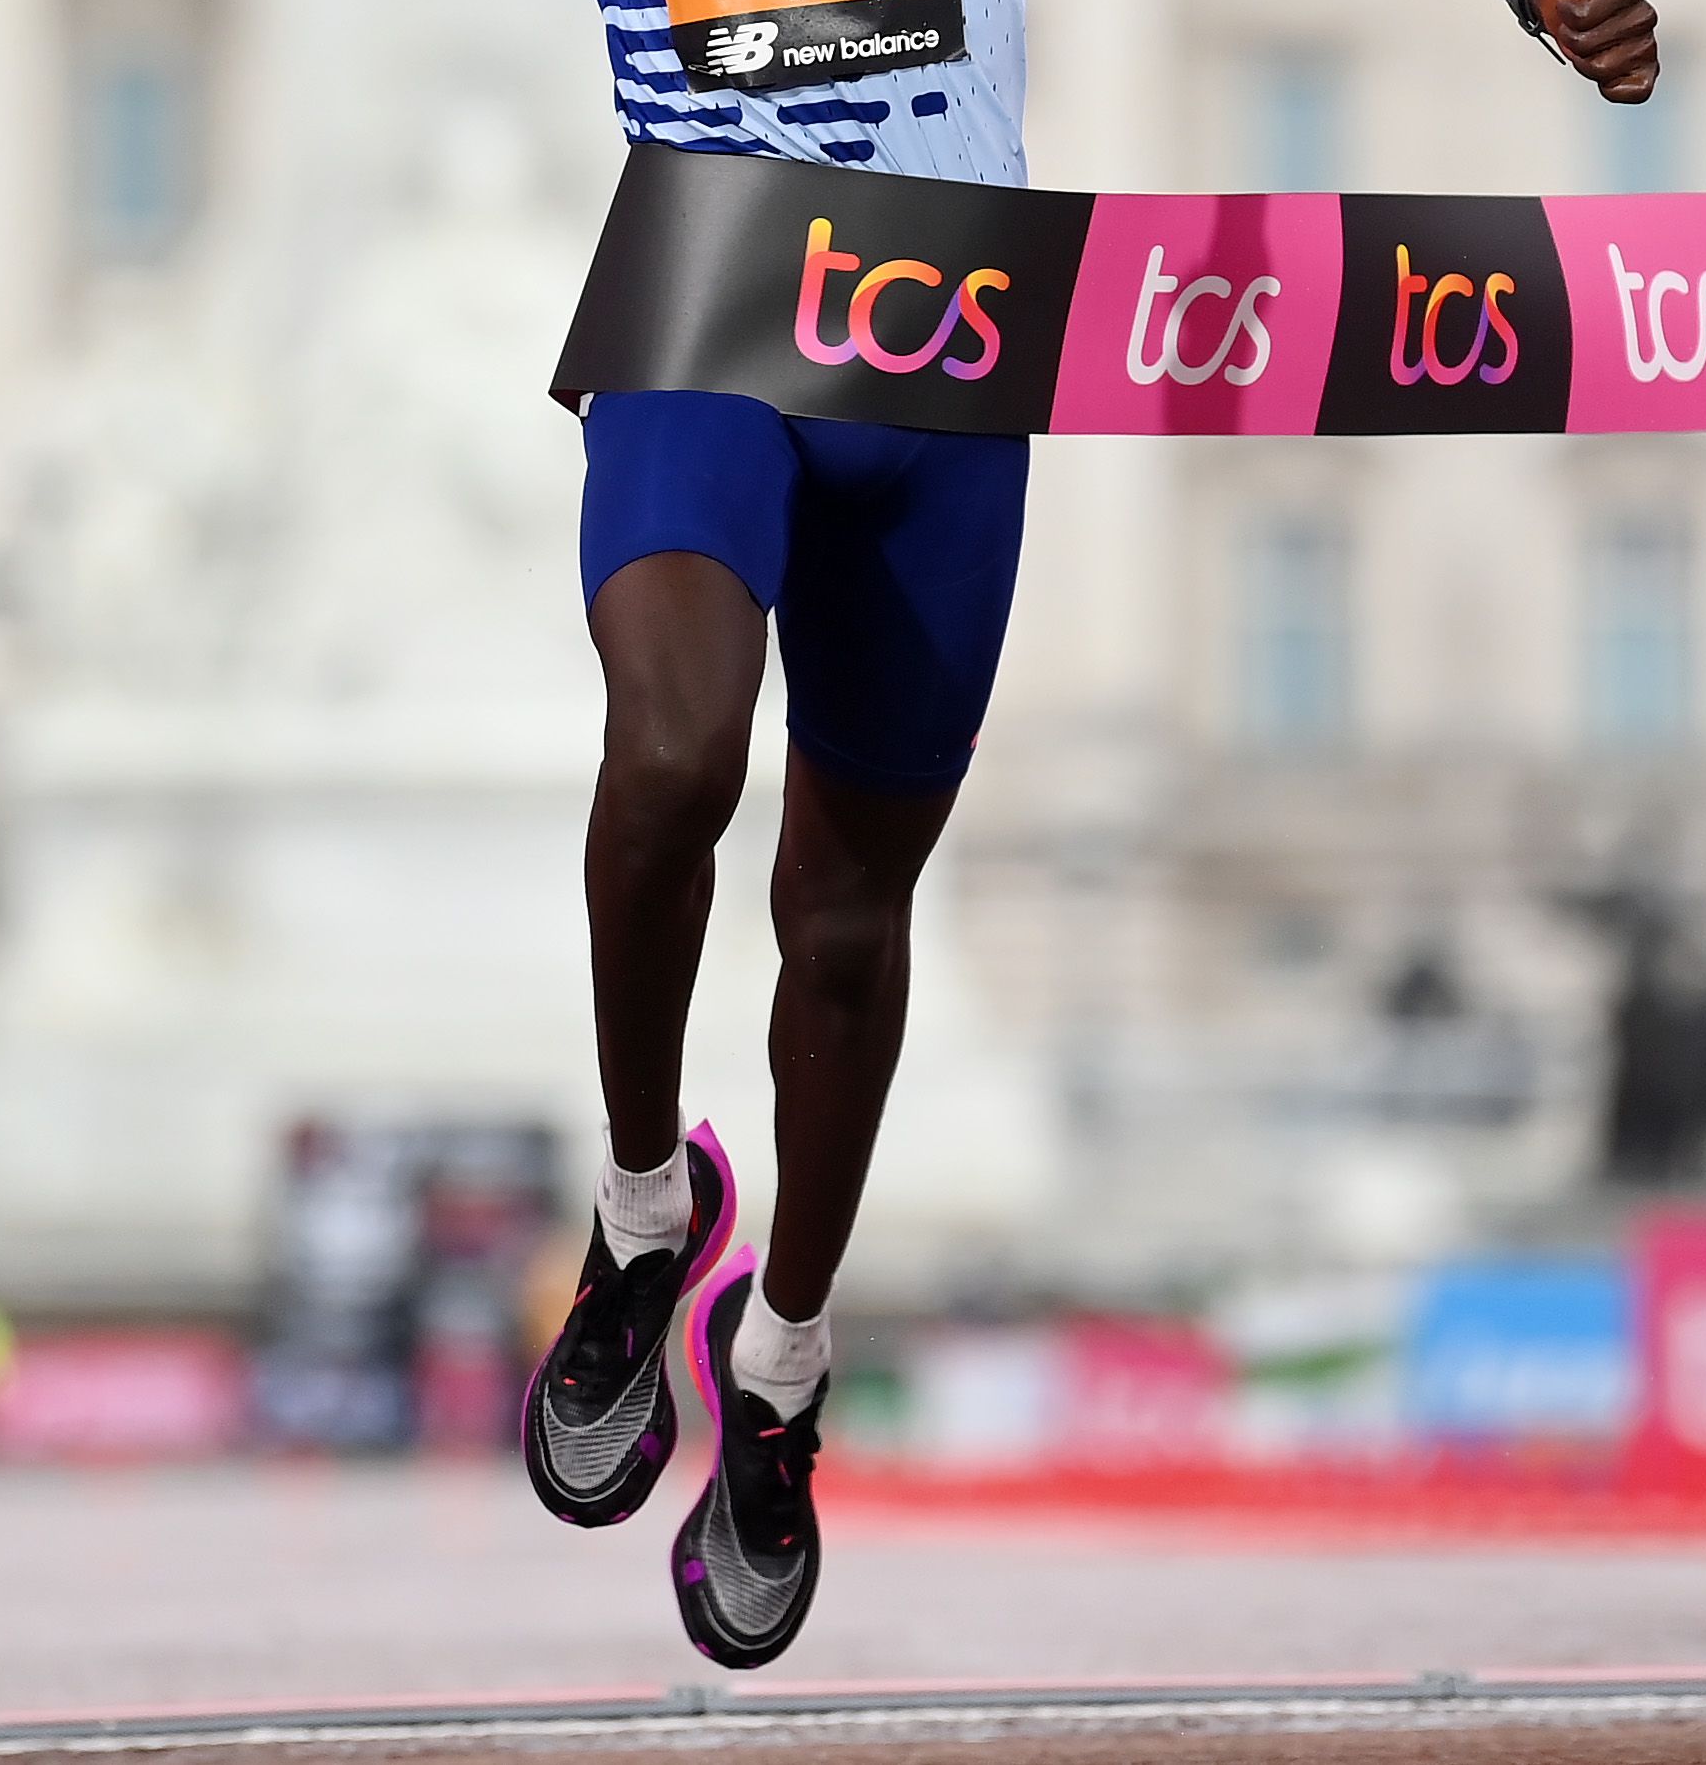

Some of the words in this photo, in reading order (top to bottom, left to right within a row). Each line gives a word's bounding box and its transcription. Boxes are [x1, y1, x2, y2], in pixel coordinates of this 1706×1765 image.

[783, 42, 836, 67] new
[840, 28, 940, 60] balance
[794, 217, 1010, 381] tcs
[1127, 245, 1281, 386] tcs
[1389, 243, 1520, 386] tcs
